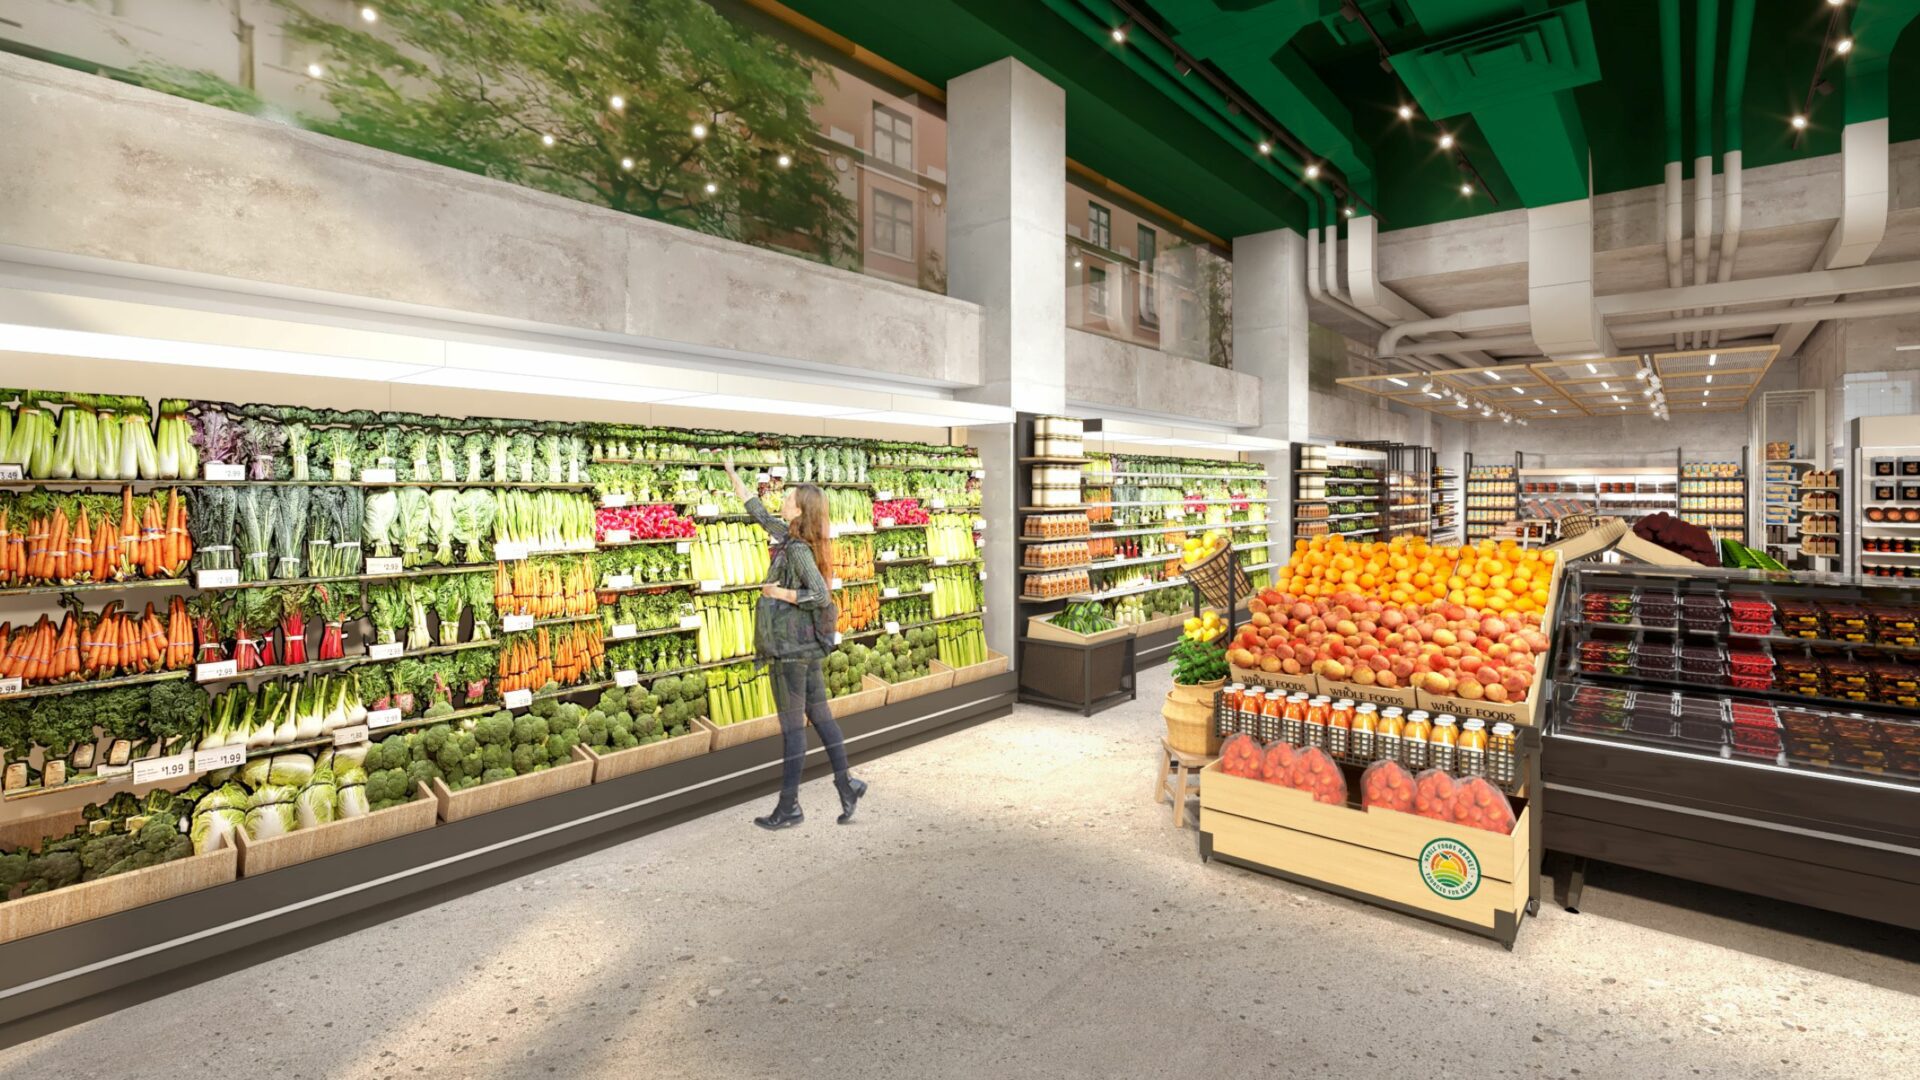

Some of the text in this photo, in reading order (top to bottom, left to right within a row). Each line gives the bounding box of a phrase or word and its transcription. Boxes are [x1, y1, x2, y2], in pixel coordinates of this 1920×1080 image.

[1242, 675, 1307, 691] WHOLE FOODS
[1329, 687, 1404, 705] WHOLE FOODS
[1431, 702, 1516, 721] WHOLE FOODS
[220, 752, 241, 765] $1.99
[161, 763, 184, 776] $1.99
